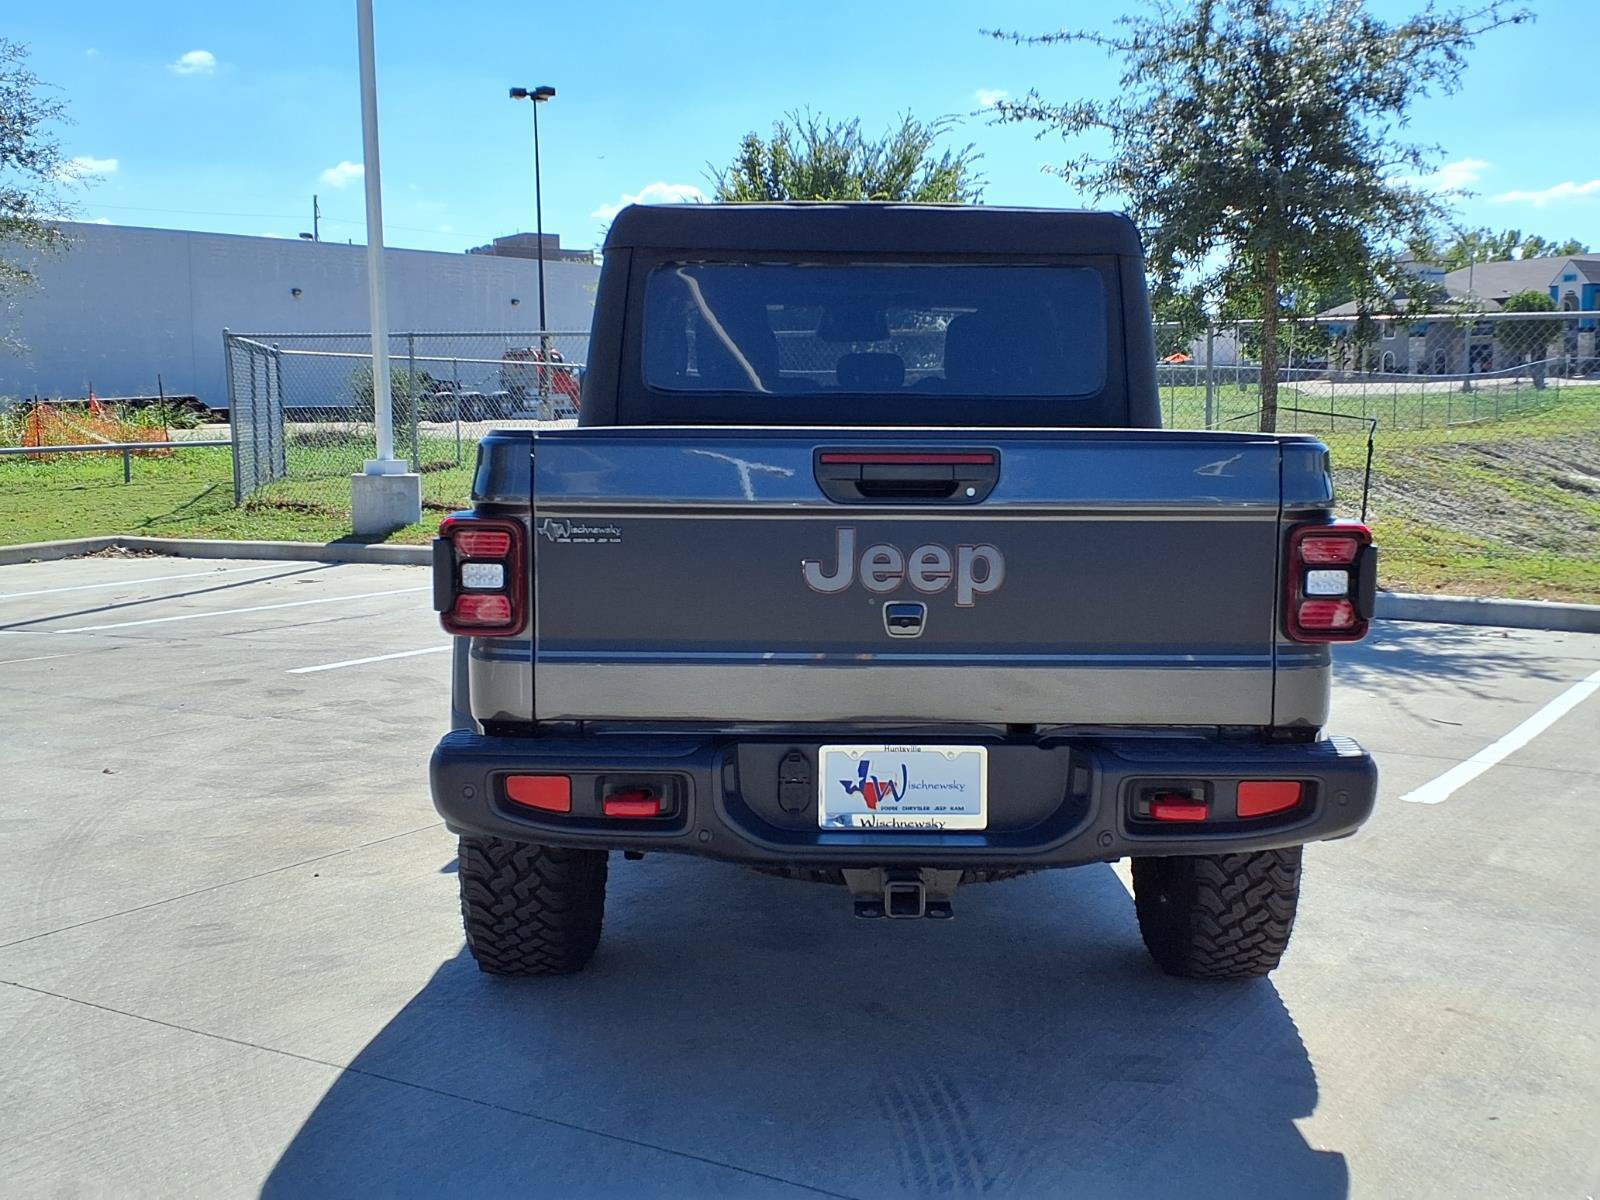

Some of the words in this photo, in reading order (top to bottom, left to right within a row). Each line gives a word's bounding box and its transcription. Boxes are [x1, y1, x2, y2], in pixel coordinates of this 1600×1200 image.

[802, 527, 1005, 608] Jeep
[884, 745, 922, 753] Huntsville
[871, 763, 966, 803] Wischnewsky
[860, 815, 946, 829] Wischnewsky
